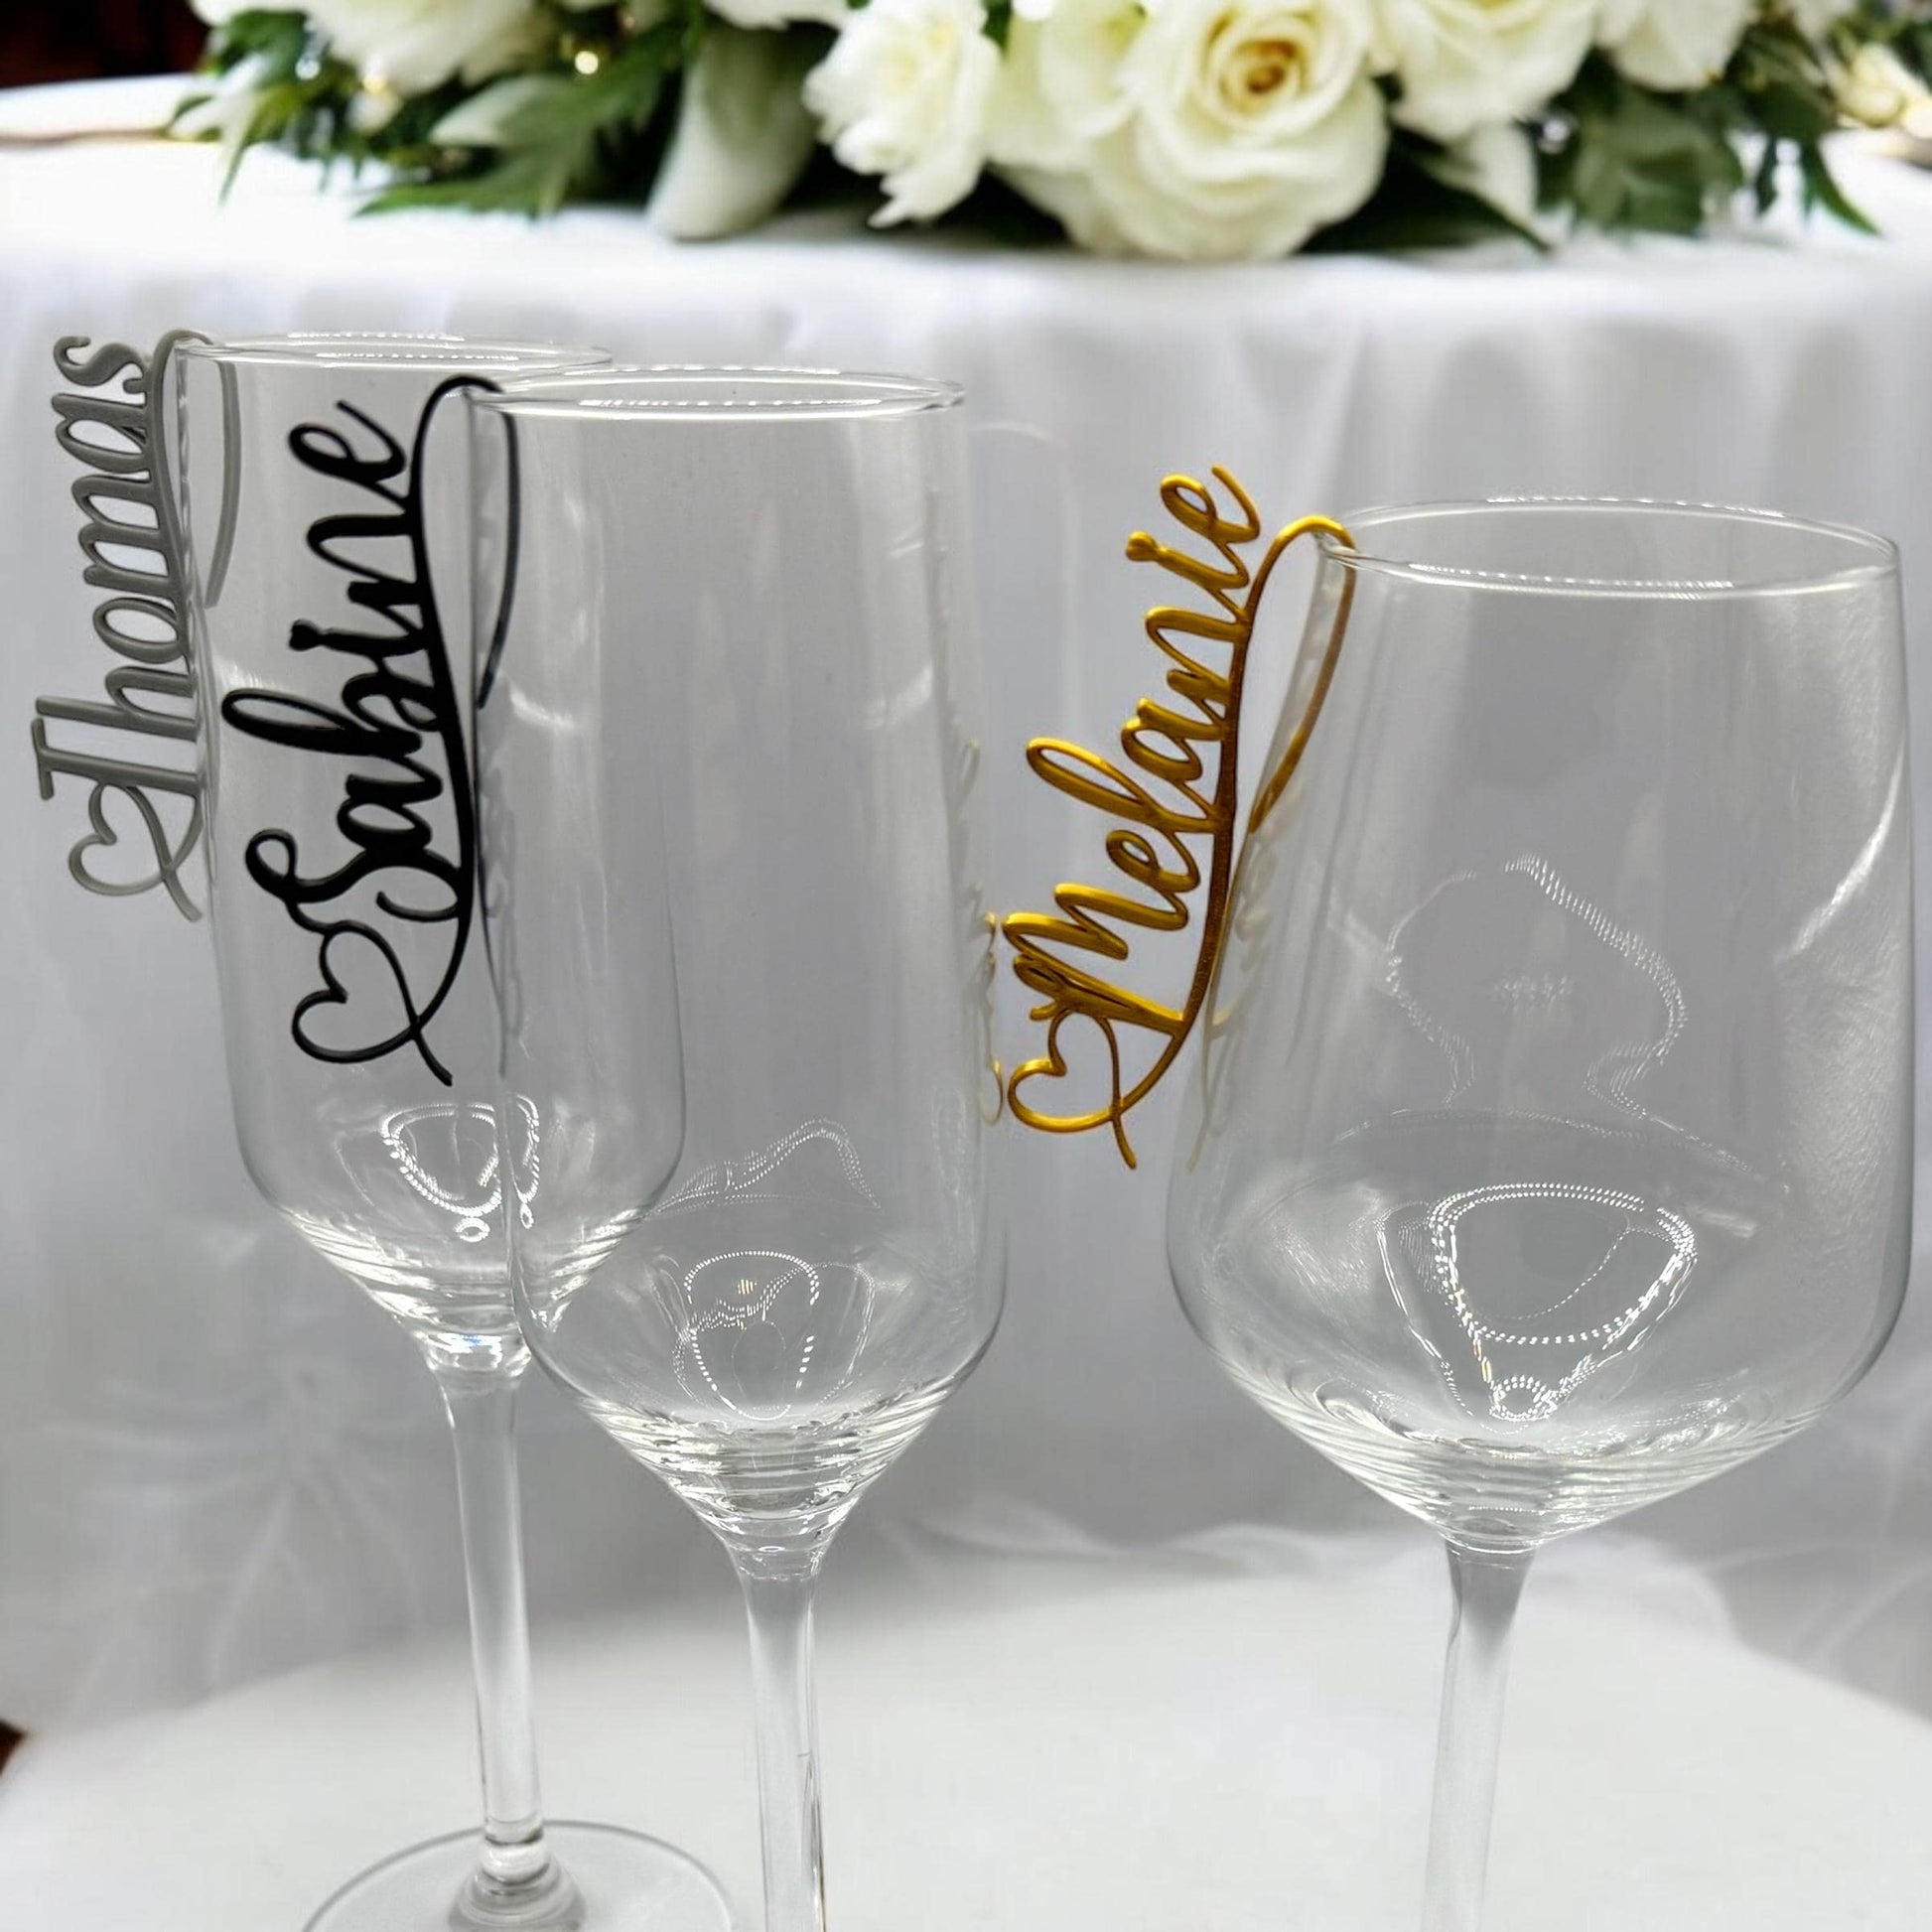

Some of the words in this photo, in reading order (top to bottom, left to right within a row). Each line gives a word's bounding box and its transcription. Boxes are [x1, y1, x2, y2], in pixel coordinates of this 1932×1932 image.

[31, 335, 202, 800] Thomas
[221, 399, 467, 923] Sabine
[1002, 465, 1261, 1035] Melanie
